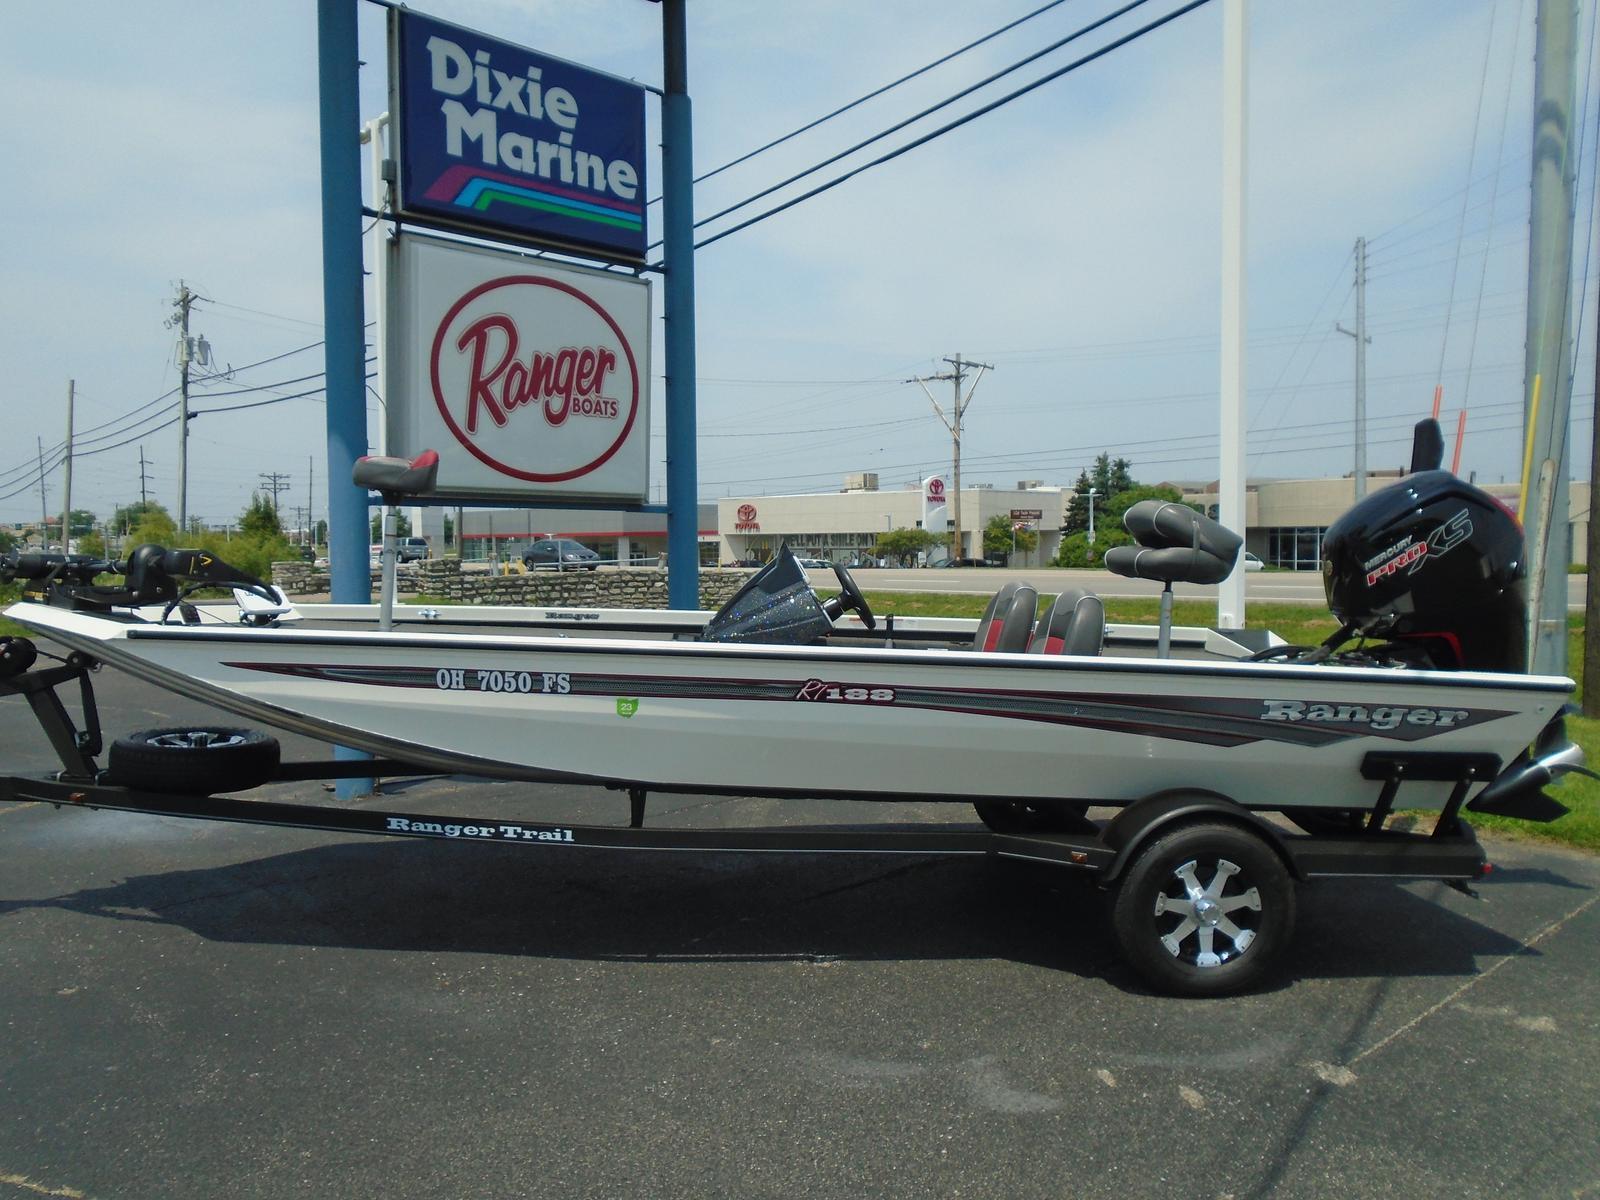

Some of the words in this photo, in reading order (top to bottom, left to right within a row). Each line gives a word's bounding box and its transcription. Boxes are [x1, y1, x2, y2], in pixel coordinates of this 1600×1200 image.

[426, 35, 579, 129] Dixie
[441, 98, 639, 200] Marine
[457, 313, 616, 434] Ranger
[572, 398, 618, 417] BOATS
[1364, 534, 1413, 571] MERCURY
[1366, 541, 1428, 586] PRO
[1408, 508, 1474, 576] XS
[544, 611, 600, 621] Ranger
[436, 668, 466, 690] OH
[477, 670, 532, 693] 7050
[542, 673, 571, 694] FS
[620, 703, 633, 711] 23
[1260, 699, 1469, 730] Ranger
[386, 817, 496, 838] Ranger
[499, 825, 575, 842] Trail
